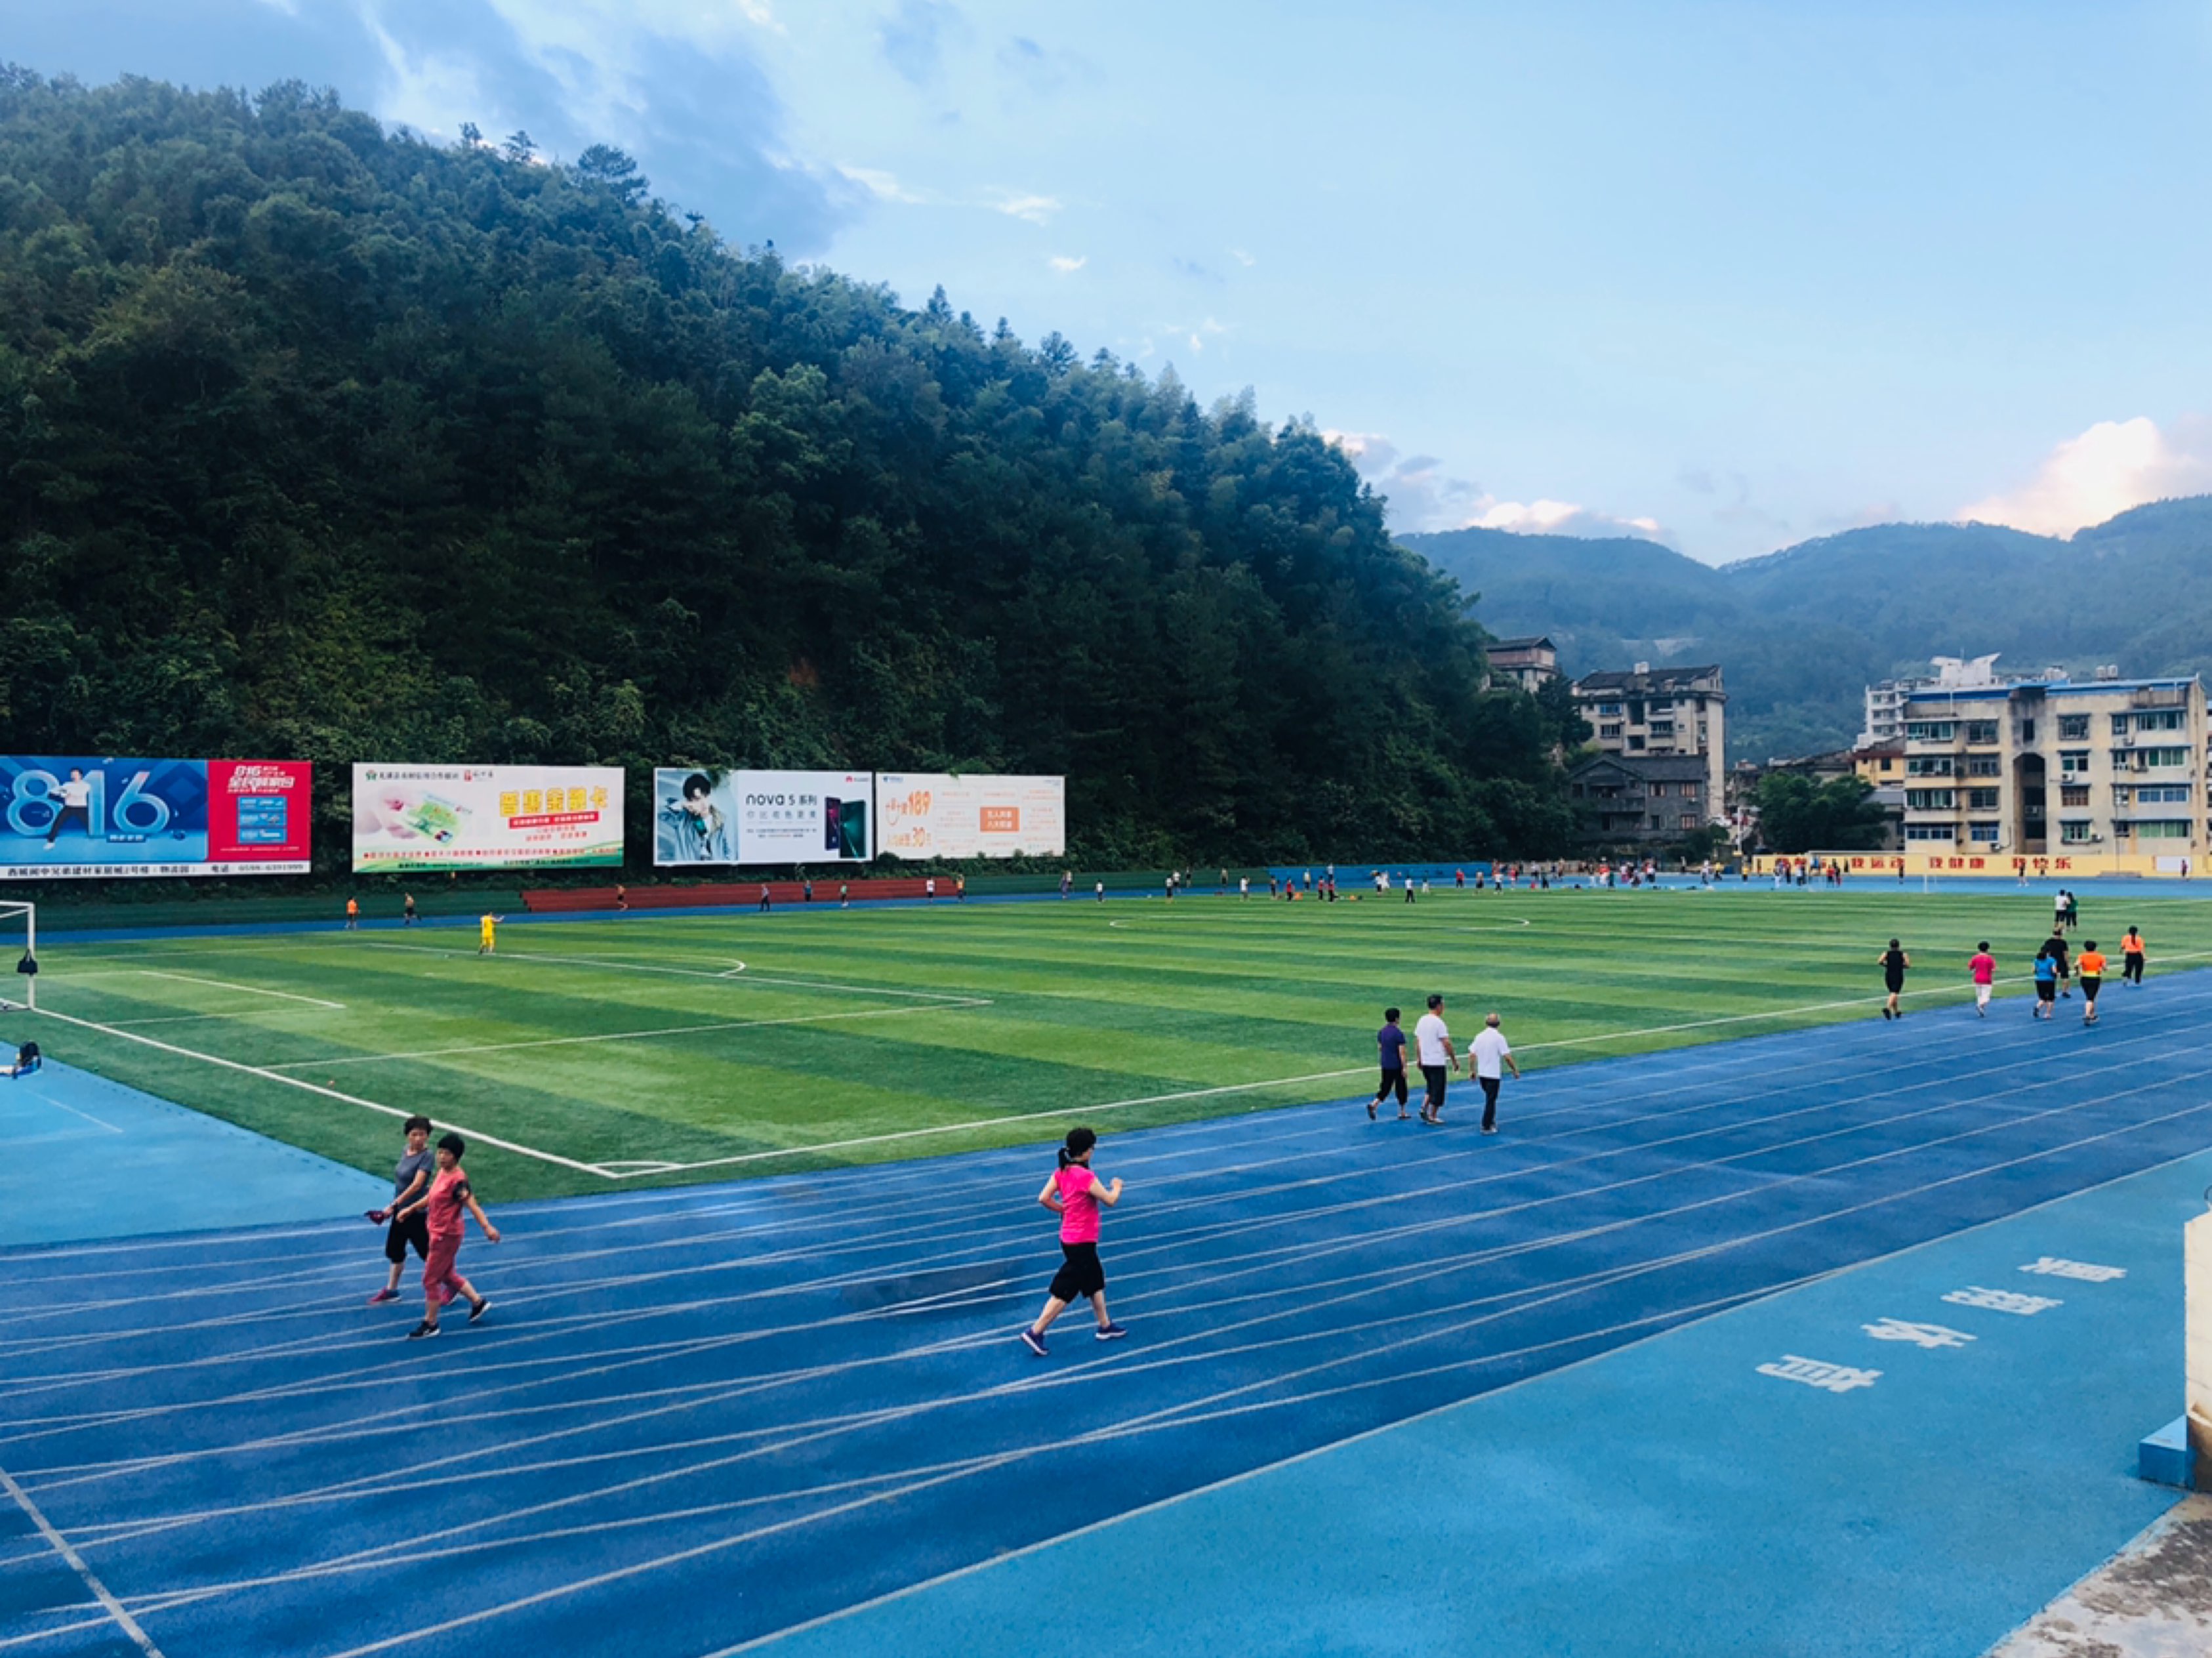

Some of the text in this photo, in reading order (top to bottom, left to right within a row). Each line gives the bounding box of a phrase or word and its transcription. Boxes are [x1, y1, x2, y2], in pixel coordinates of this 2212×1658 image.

[7, 769, 169, 836] 816
[746, 793, 785, 806] nova
[1929, 857, 1984, 869] 我健康
